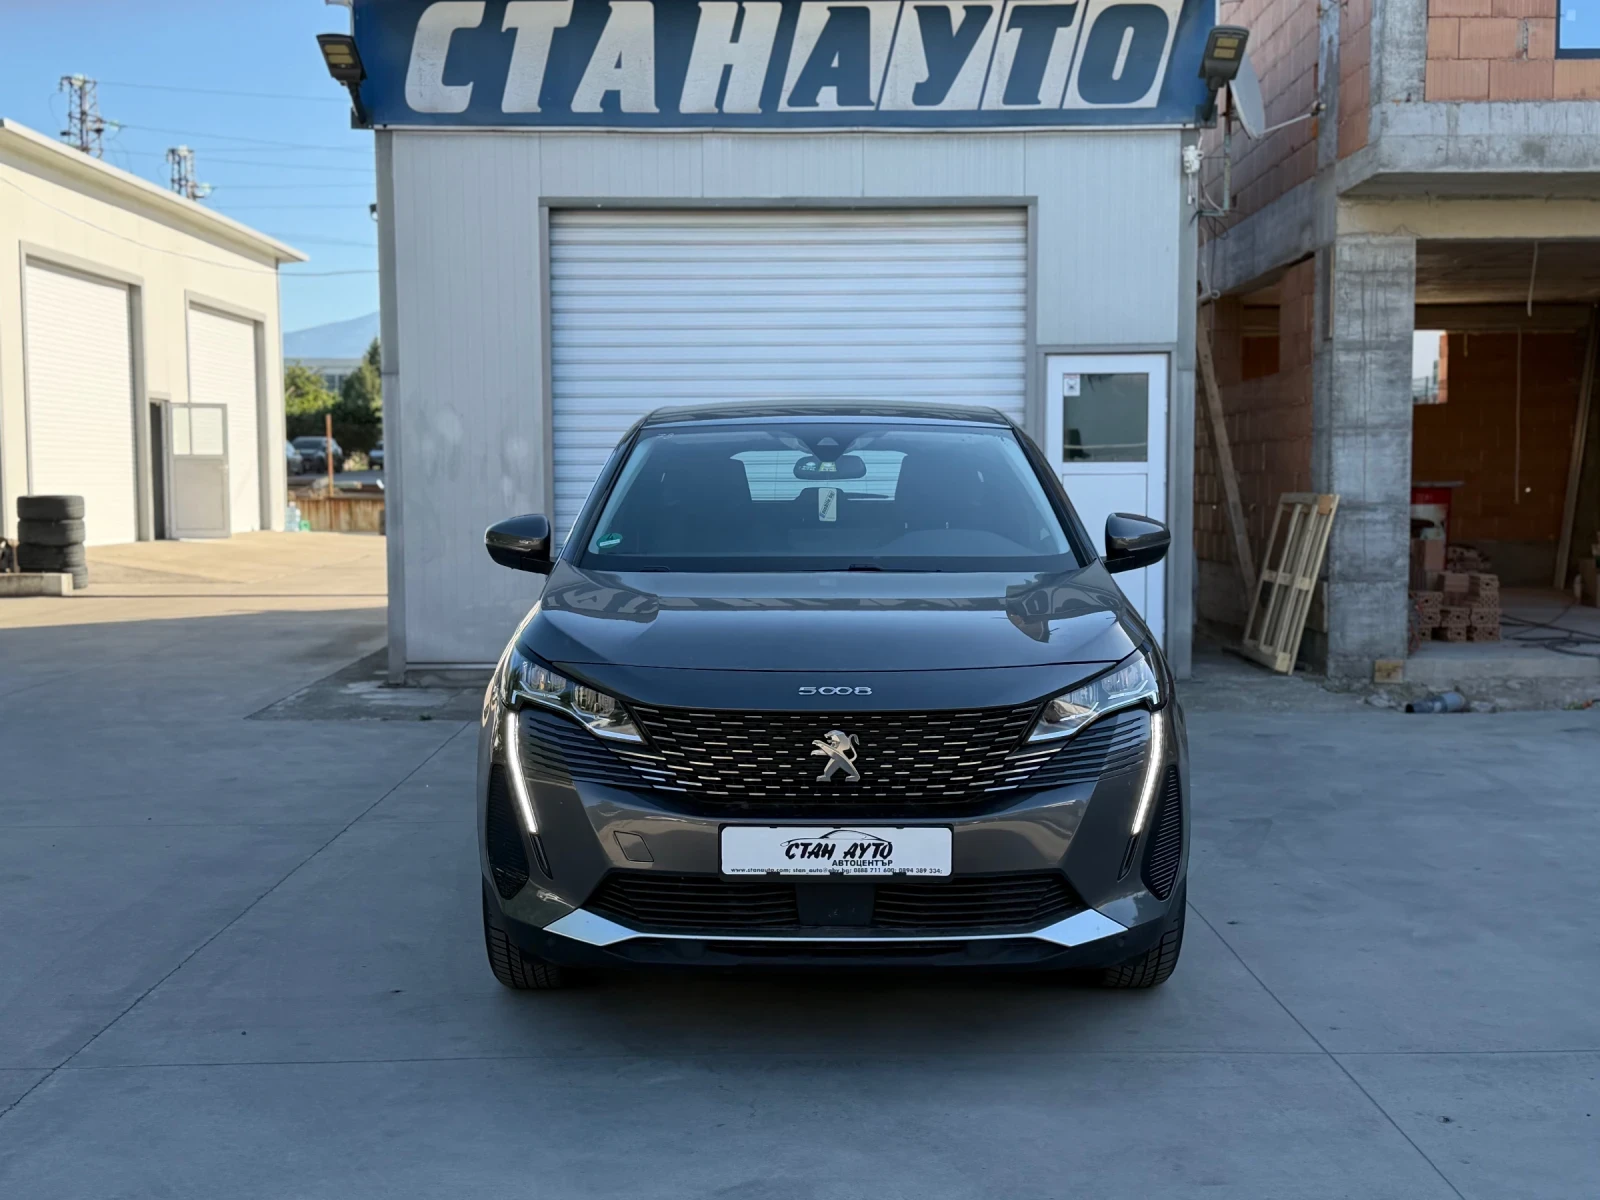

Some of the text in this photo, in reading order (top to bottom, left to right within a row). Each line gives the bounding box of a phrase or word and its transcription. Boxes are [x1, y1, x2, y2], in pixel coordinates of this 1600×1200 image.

[799, 686, 873, 695] 5008
[785, 841, 893, 860] СТАН АУТО
